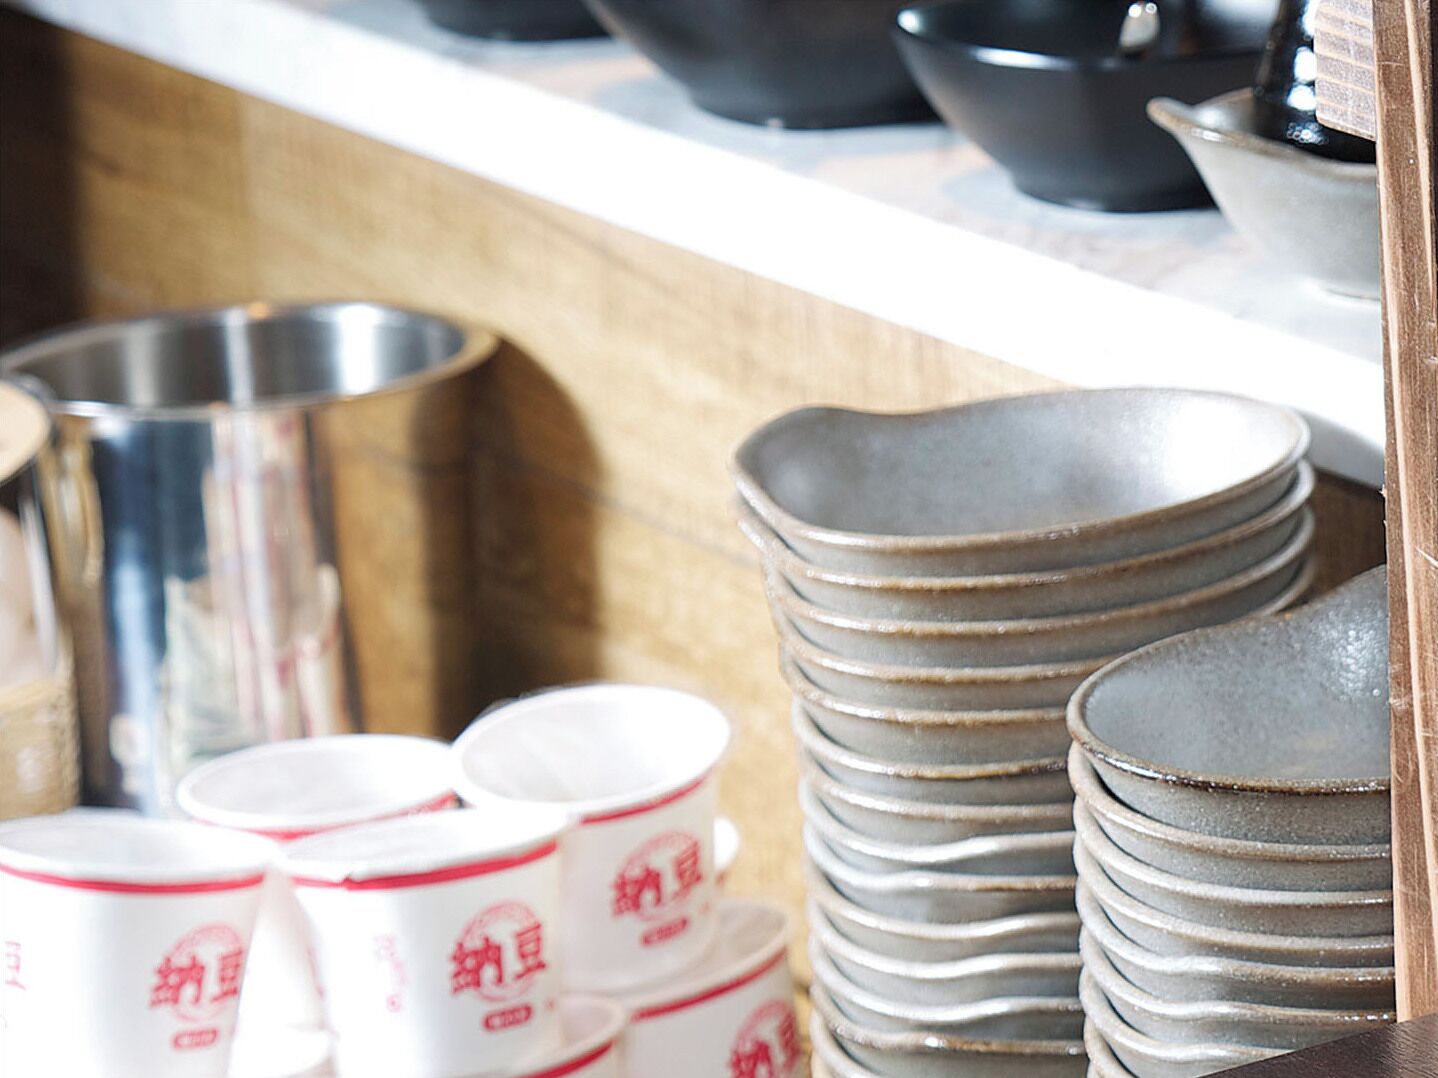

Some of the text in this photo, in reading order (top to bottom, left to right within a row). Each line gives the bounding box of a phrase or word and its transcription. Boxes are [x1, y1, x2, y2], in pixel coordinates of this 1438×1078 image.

[612, 840, 703, 918] 納豆
[148, 947, 244, 1008] 納豆
[449, 922, 547, 994] 納豆
